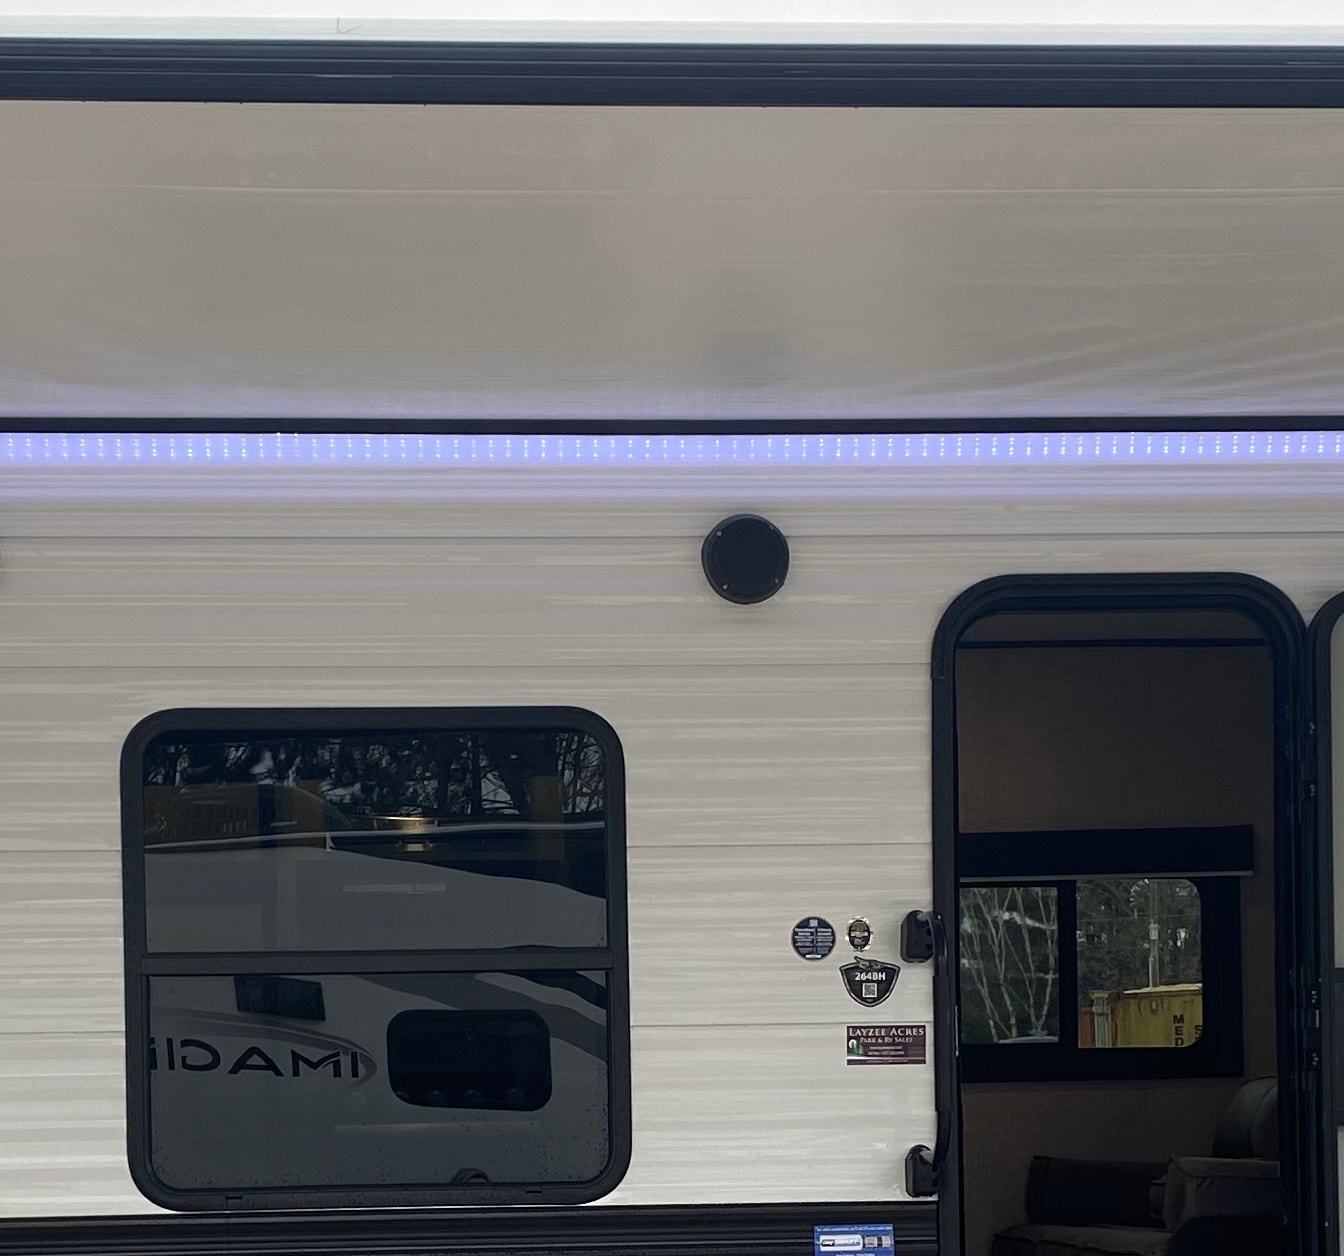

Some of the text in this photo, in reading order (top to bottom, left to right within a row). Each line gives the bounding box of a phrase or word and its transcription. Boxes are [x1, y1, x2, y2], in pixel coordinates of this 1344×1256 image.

[854, 971, 886, 981] 264BH
[849, 1027, 925, 1037] LAYZEE ACRES
